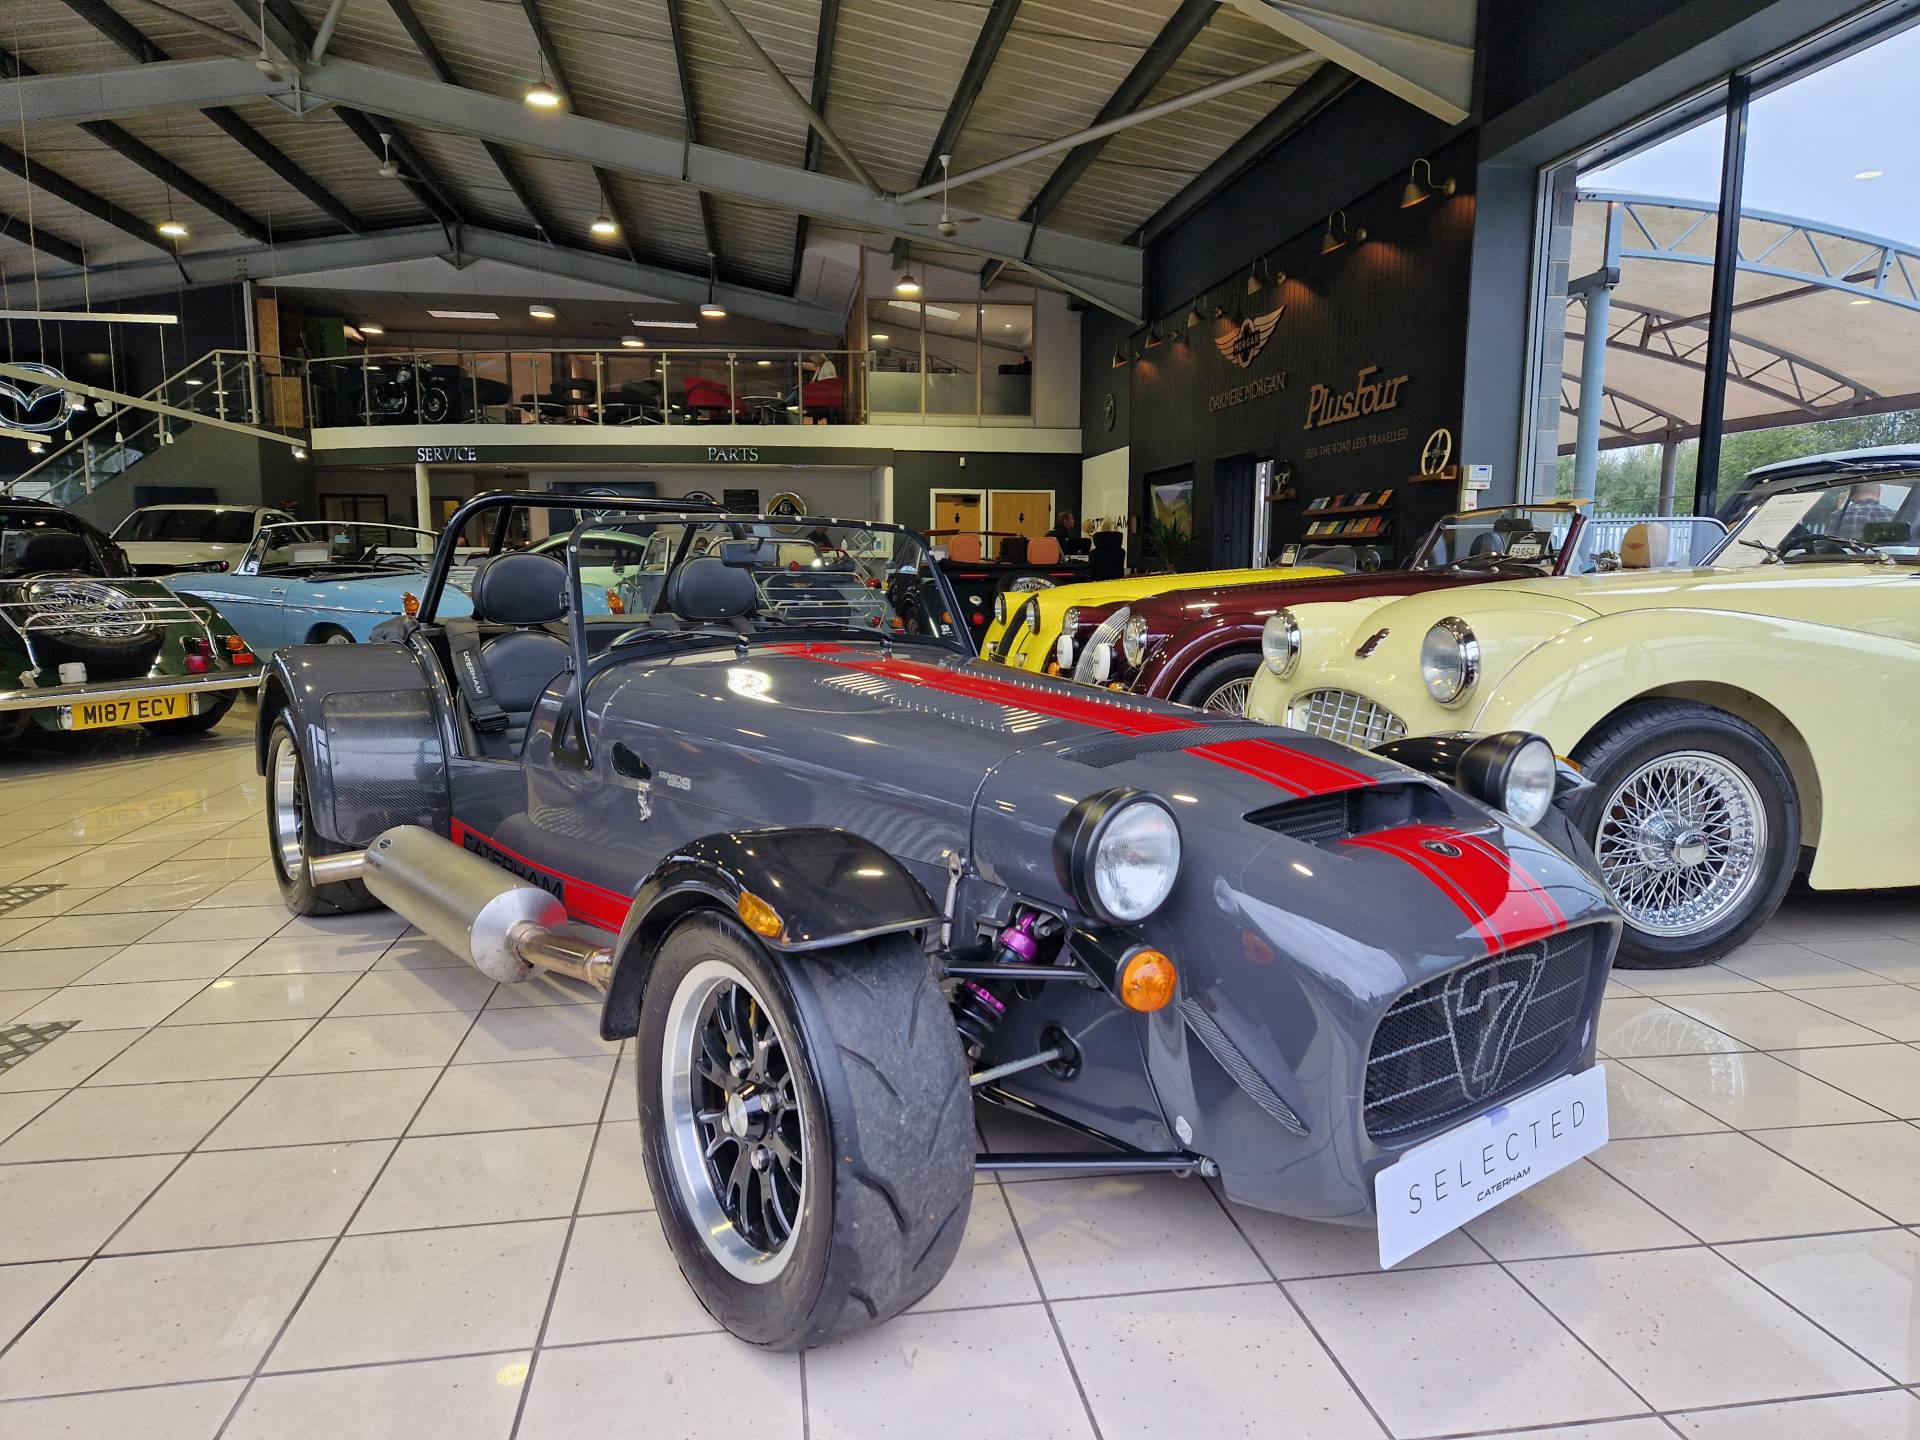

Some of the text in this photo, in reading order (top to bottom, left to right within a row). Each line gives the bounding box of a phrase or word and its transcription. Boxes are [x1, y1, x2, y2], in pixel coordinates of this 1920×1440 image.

[1234, 333, 1260, 351] MORGAN
[1208, 372, 1287, 412] OAKMERE MORGAN
[417, 447, 477, 462] SERVICE
[708, 447, 759, 461] PARTS
[1304, 427, 1409, 459] SEEK THE ROAD LESS TRAVELLED
[463, 651, 483, 694] CATERHAM
[83, 697, 175, 724] M187 ECV
[1409, 1100, 1585, 1214] SELECTED
[1477, 1166, 1531, 1202] CATERHAM
